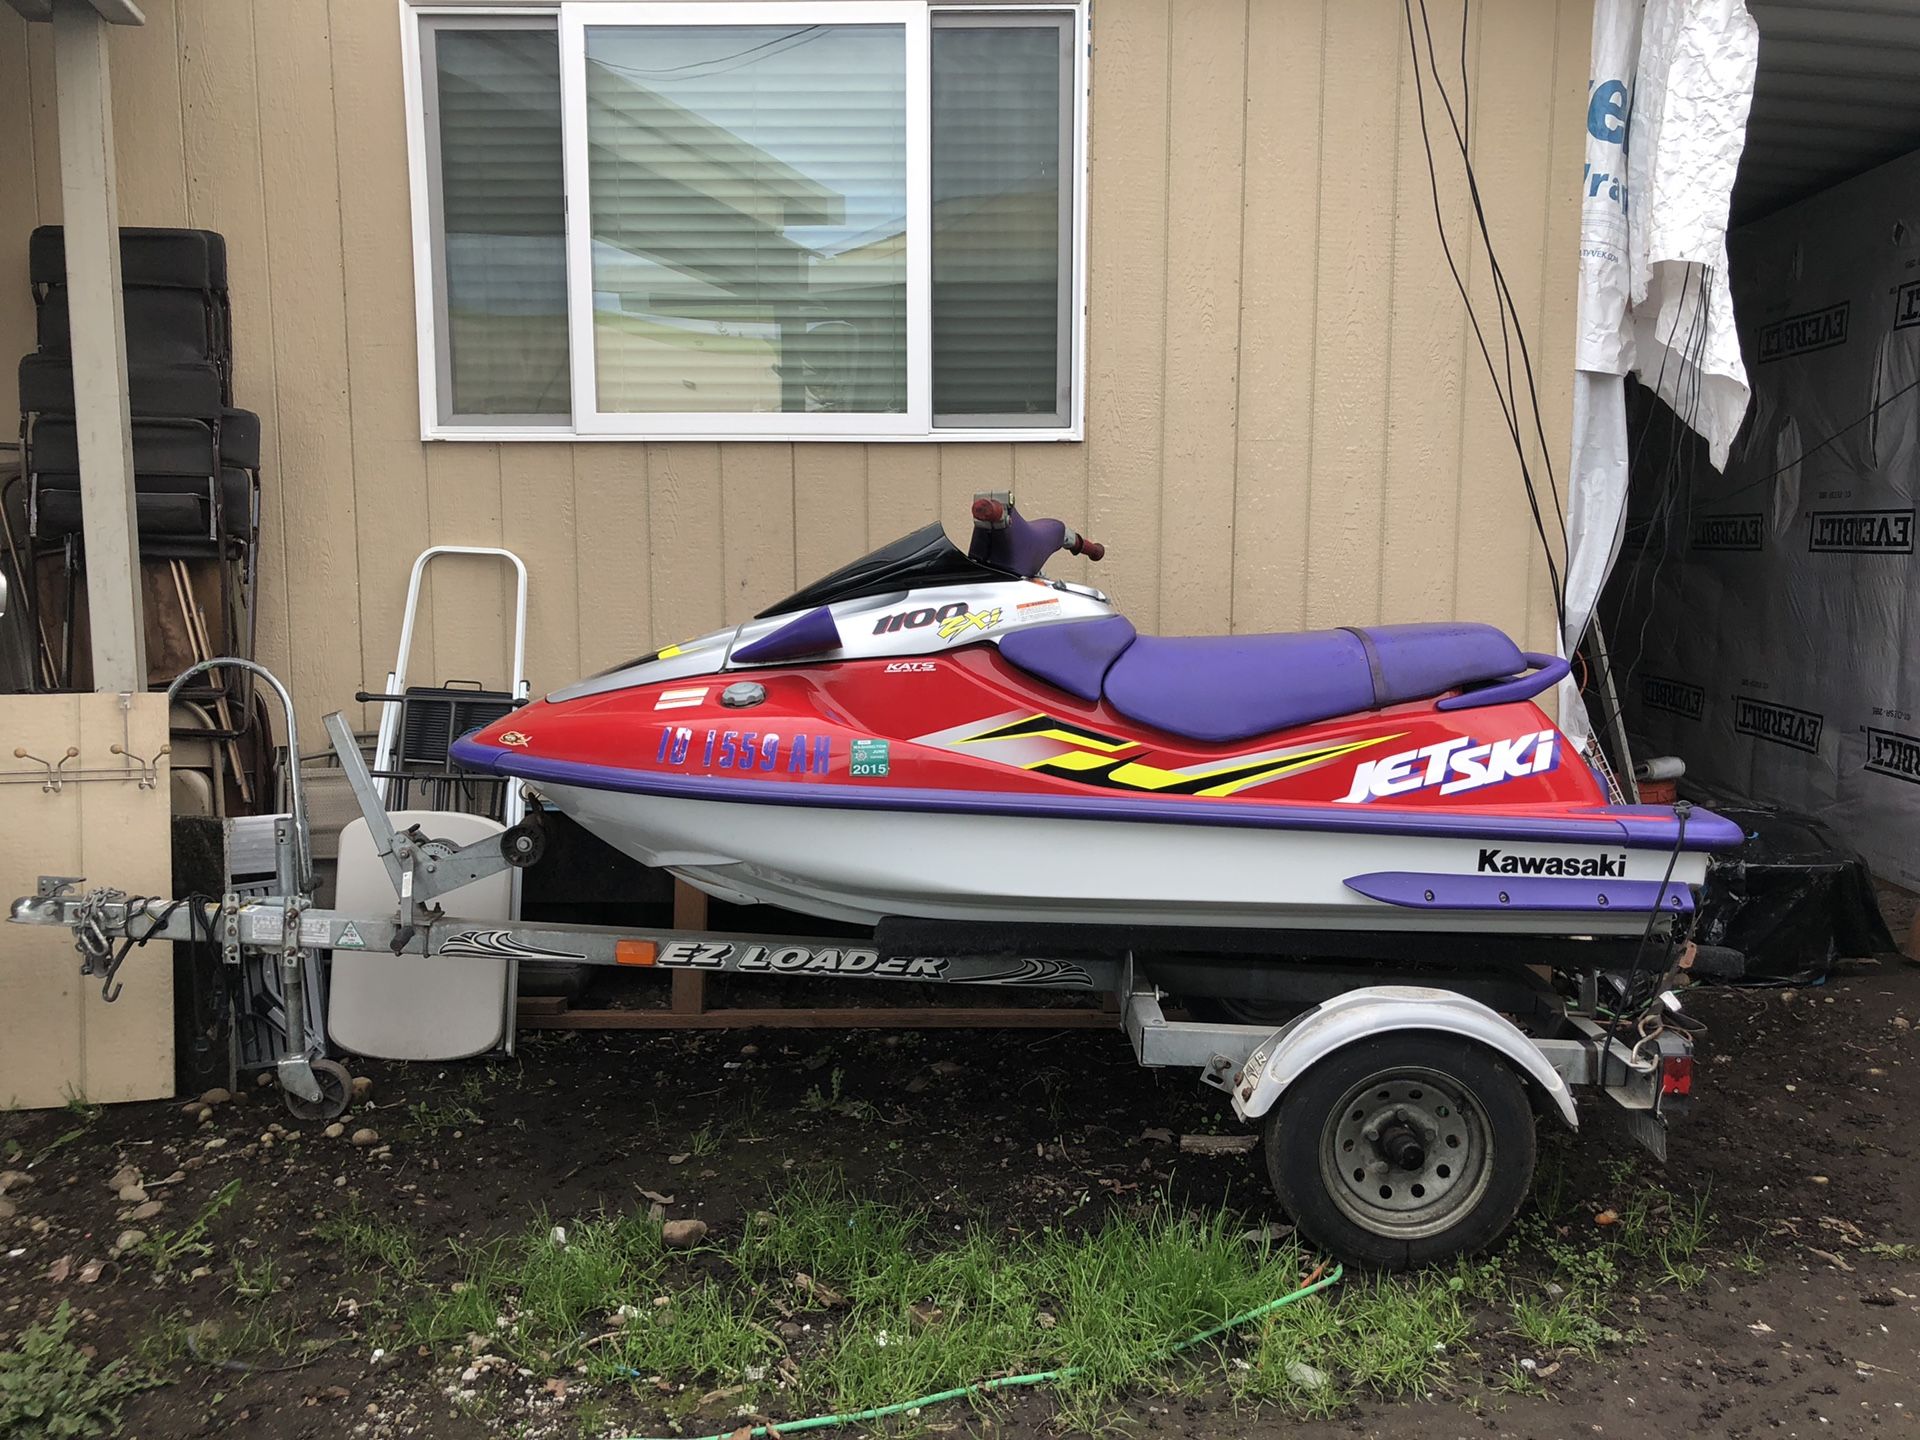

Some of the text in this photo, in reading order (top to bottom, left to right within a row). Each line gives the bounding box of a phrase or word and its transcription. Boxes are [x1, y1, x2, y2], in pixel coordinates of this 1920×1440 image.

[1814, 517, 1911, 547] EVERBILT
[872, 602, 969, 635] 1100
[886, 661, 936, 671] KATS
[1738, 703, 1819, 747] EVERBILT
[656, 726, 831, 774] ID 1559 AH
[853, 764, 886, 775] 2015
[1478, 849, 1627, 877] Kawasaki
[658, 942, 950, 979] EZ LOADER
